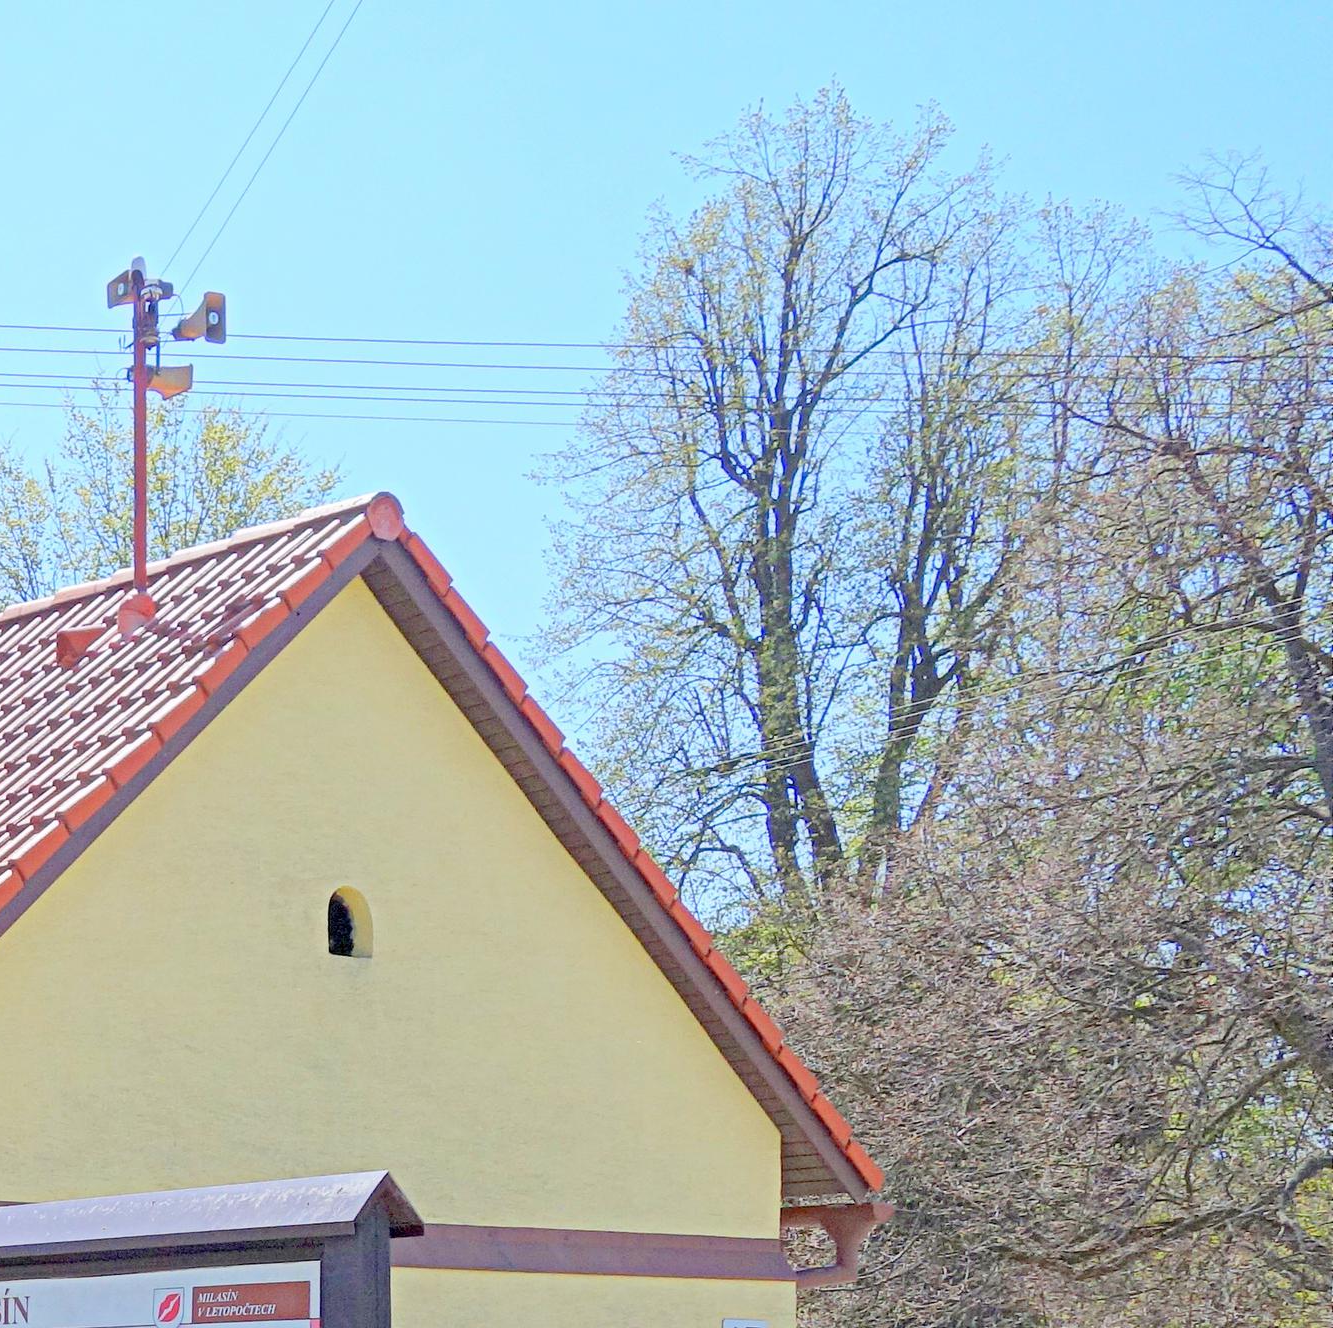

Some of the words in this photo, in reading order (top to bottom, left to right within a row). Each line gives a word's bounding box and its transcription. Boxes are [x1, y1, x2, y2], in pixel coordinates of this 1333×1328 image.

[196, 1288, 239, 1303] MILASÍN
[197, 1306, 206, 1317] V
[205, 1303, 277, 1317] LETOPOČTECH
